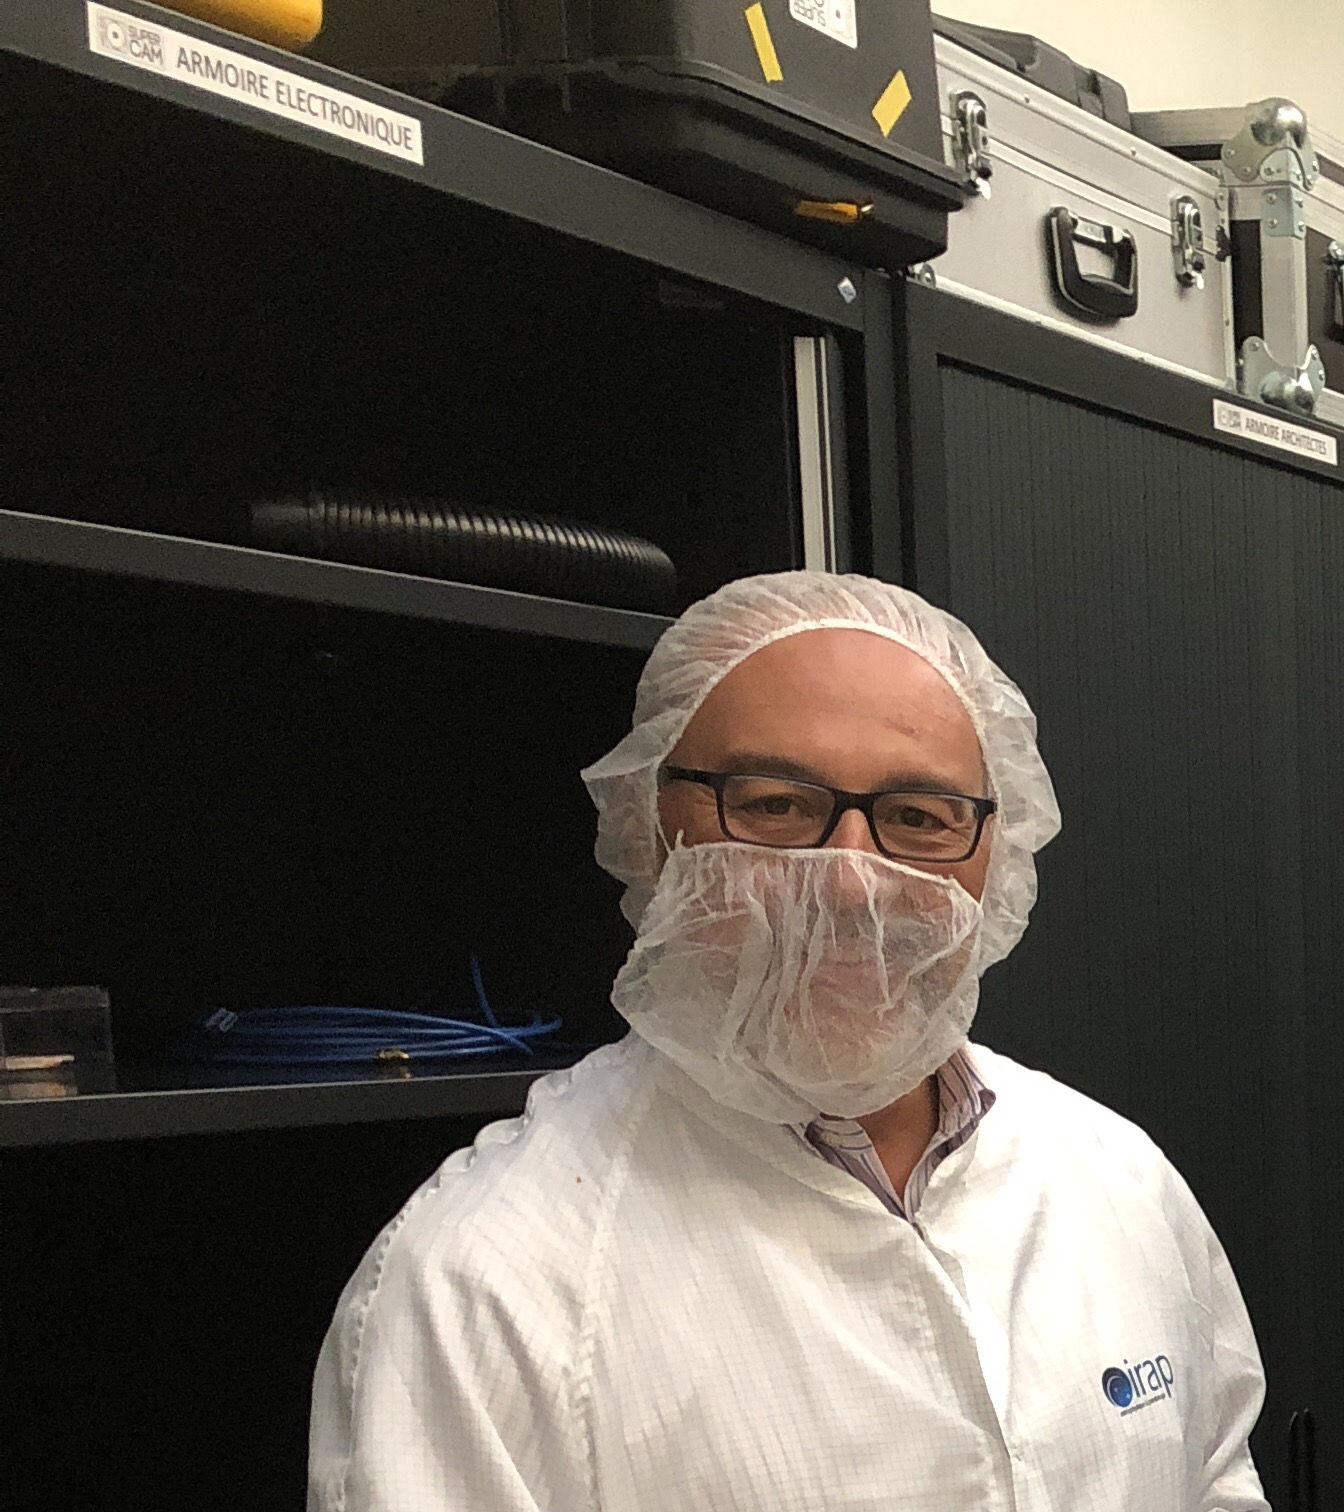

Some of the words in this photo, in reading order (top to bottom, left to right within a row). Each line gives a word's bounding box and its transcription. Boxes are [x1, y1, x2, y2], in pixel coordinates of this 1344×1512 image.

[128, 38, 163, 66] CAM
[176, 46, 270, 100] ARMOIRE
[274, 79, 414, 151] ELECTRONIQUE
[1123, 1354, 1174, 1399] irap
